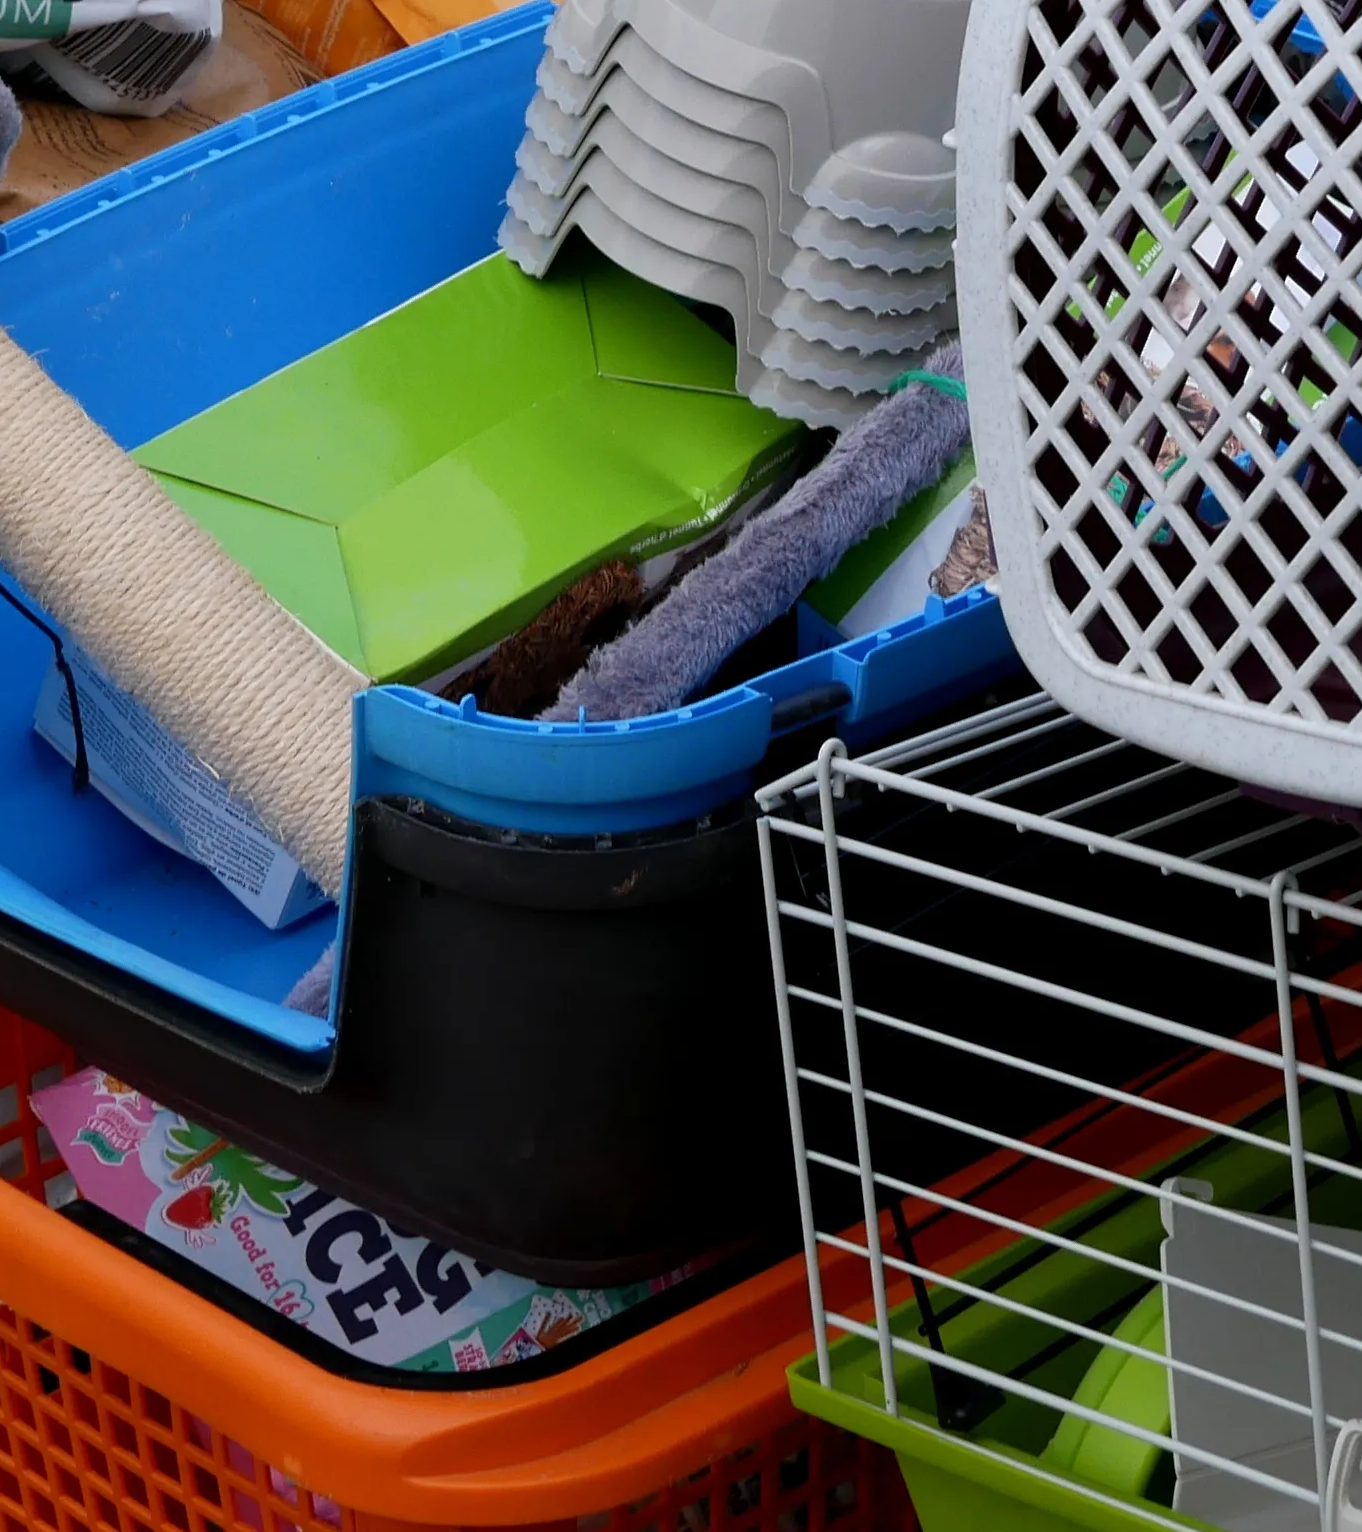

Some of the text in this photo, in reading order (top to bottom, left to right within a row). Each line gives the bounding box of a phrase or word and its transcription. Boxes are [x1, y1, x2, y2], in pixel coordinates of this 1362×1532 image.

[229, 1214, 301, 1316] Good for 16
